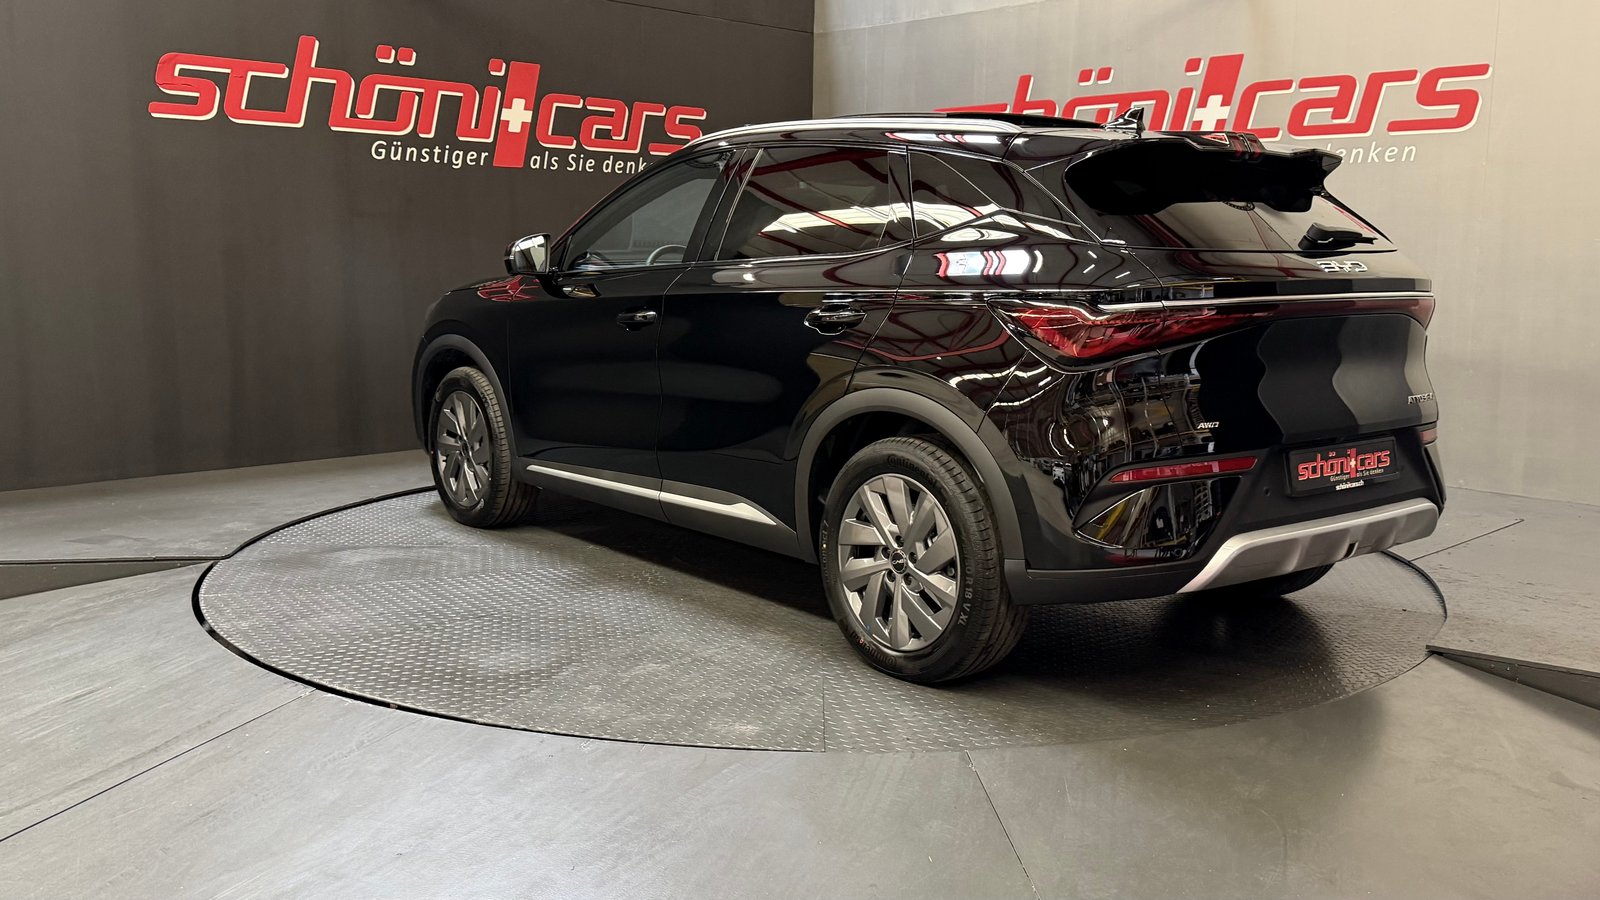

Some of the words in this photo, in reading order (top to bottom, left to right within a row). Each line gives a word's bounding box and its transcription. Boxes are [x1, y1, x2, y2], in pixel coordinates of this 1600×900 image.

[371, 140, 489, 169] Günstiger
[530, 151, 559, 170] als
[567, 153, 595, 172] Sie
[603, 155, 648, 175] denk
[1316, 261, 1368, 273] BYD
[1197, 421, 1220, 429] AWD
